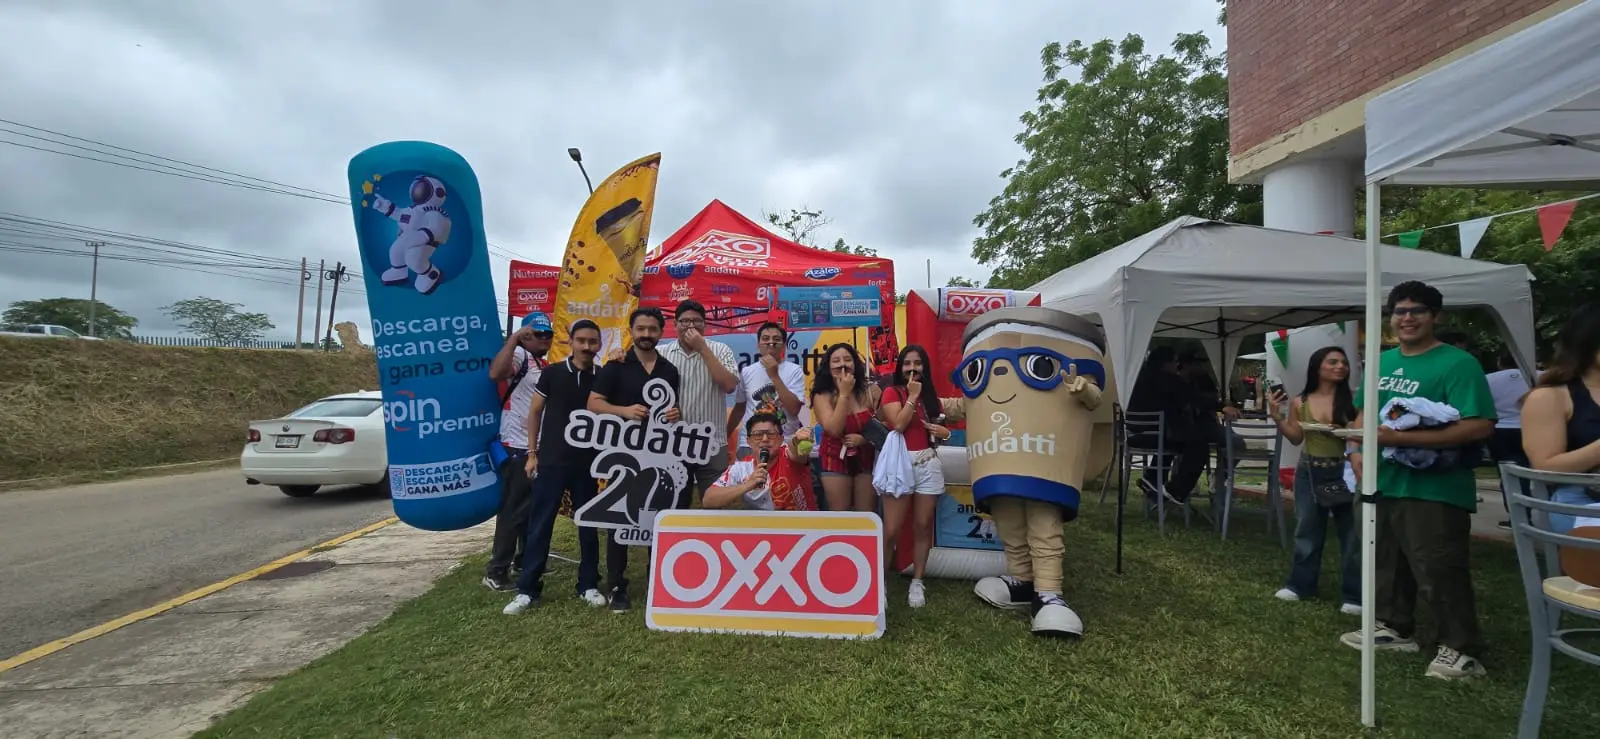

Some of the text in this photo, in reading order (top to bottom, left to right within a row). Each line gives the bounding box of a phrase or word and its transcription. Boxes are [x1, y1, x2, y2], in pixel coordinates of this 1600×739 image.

[519, 292, 548, 301] OXXO
[949, 295, 1005, 313] OXXO
[373, 315, 487, 338] Descarga,
[377, 337, 469, 359] escanea
[389, 361, 444, 385] gana
[453, 356, 491, 374] con
[1377, 376, 1420, 395] EXICO
[383, 397, 441, 429] spin
[418, 411, 495, 439] premia
[569, 414, 712, 460] andatti
[405, 462, 474, 477] DESCARGA,
[406, 470, 472, 486] ESCANEA Y
[407, 479, 471, 495] GANA MÁS
[661, 537, 872, 608] OXXO
